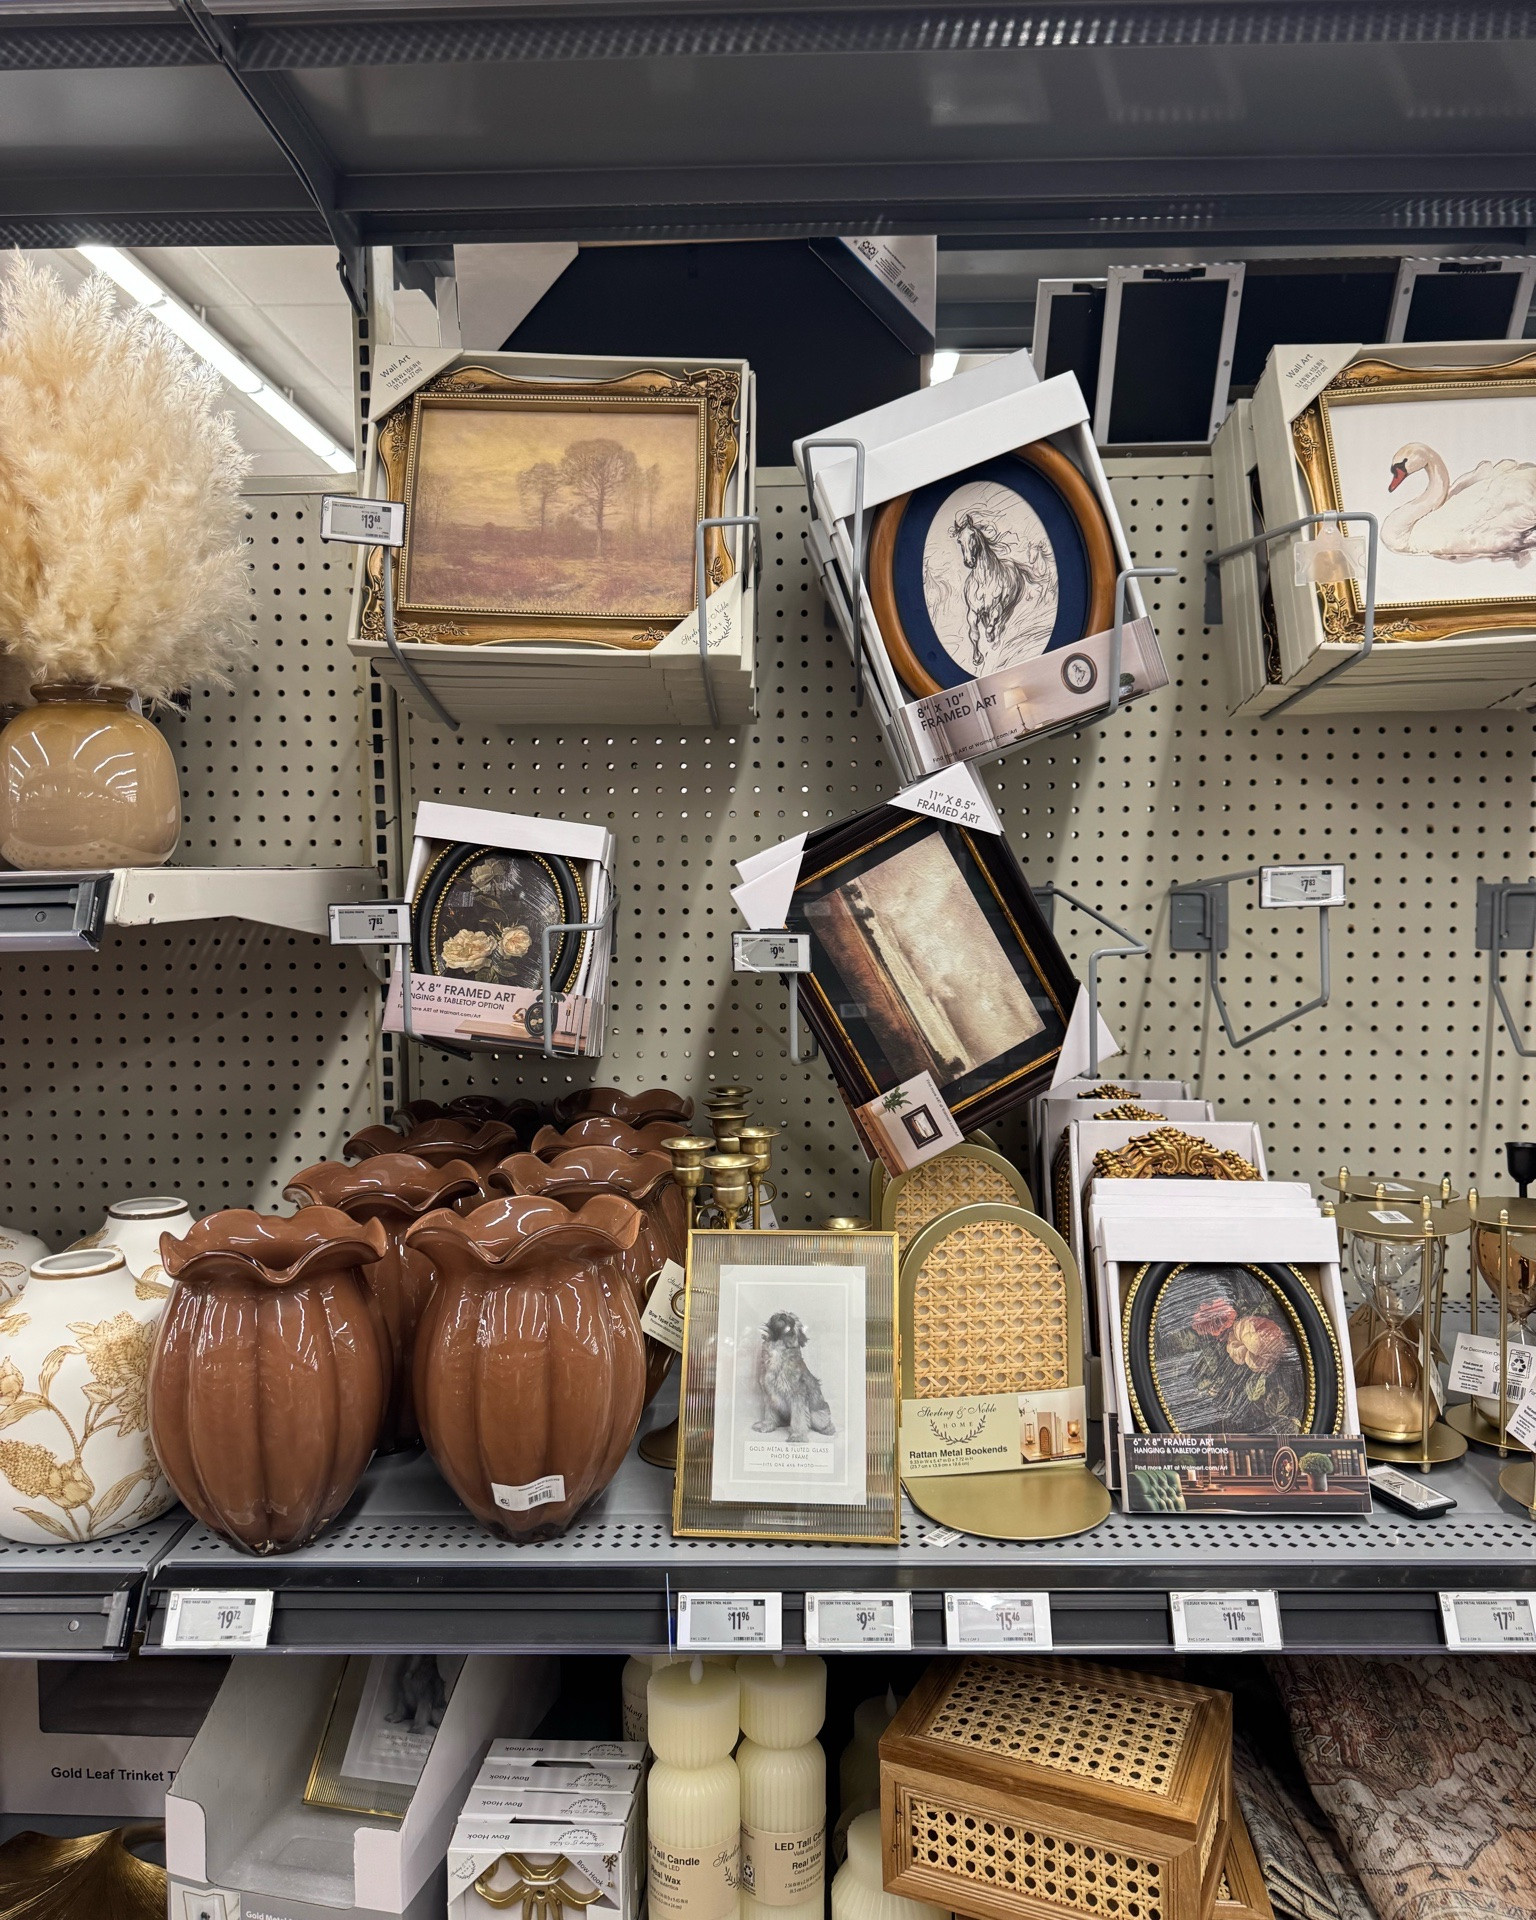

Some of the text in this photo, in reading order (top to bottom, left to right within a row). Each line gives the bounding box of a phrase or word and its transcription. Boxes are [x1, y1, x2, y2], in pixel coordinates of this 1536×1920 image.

[380, 354, 411, 378] Wall Art
[1286, 354, 1313, 378] Wall Art
[920, 694, 998, 732] FRAMED ART
[932, 755, 944, 763] Find
[958, 746, 968, 754] ART
[974, 728, 1018, 748] Walmart.com/Art
[945, 795, 954, 805] X
[917, 799, 980, 824] FRAMED ART
[400, 991, 435, 1002] HNGING
[444, 997, 476, 1007] TABLETOP
[477, 1001, 504, 1010] OPTION
[417, 982, 426, 991] X
[444, 985, 492, 999] FRAMED
[494, 992, 516, 1003] ART
[440, 1009, 481, 1019] Walmart.com/Art
[648, 1310, 682, 1332] Bow Taper Candle
[669, 1315, 680, 1324] Large
[1469, 1346, 1493, 1355] Decoration
[917, 1402, 997, 1420] Sterling & Noble
[1144, 1438, 1150, 1446] X
[1163, 1438, 1197, 1446] FRAMED
[1199, 1438, 1214, 1446] ART
[910, 1445, 1008, 1459] Rattan Metal Bookends
[51, 1767, 164, 1781] Gold Leaf Trinket
[774, 1828, 825, 1851] LED Tall Can
[653, 1846, 700, 1866] Tall Candle
[792, 1851, 822, 1870] Real Wax
[577, 1859, 604, 1886] Bow Hook
[651, 1864, 681, 1885] Real Wax
[668, 1864, 680, 1872] LED
[246, 1911, 264, 1920] Gold
